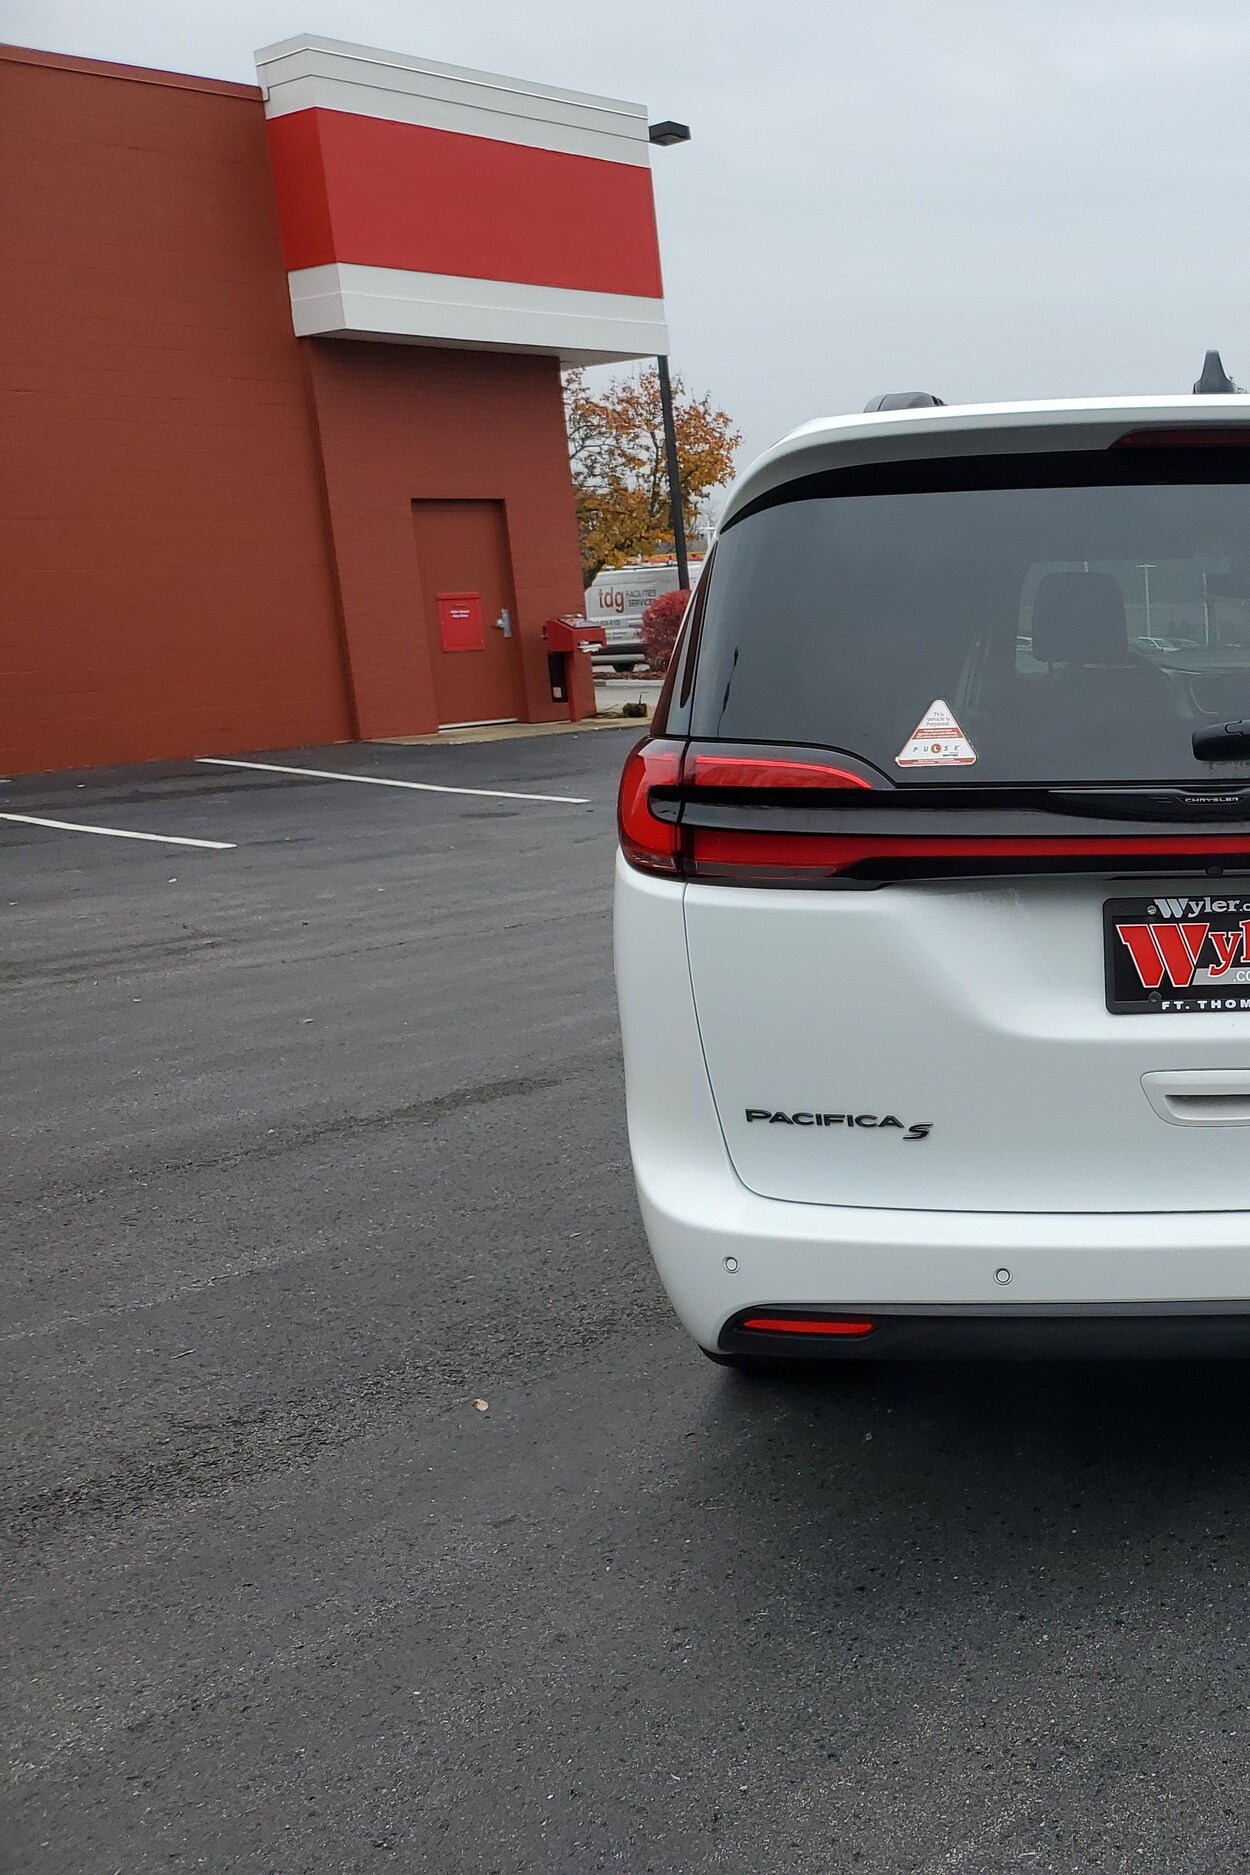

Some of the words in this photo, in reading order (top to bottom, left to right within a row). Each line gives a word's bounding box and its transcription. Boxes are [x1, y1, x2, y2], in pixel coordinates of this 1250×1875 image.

[599, 587, 625, 613] tdg
[913, 743, 960, 753] PULSE
[1161, 1001, 1190, 1010] FT.
[745, 1109, 904, 1128] PACIFICA
[902, 1122, 933, 1140] S
